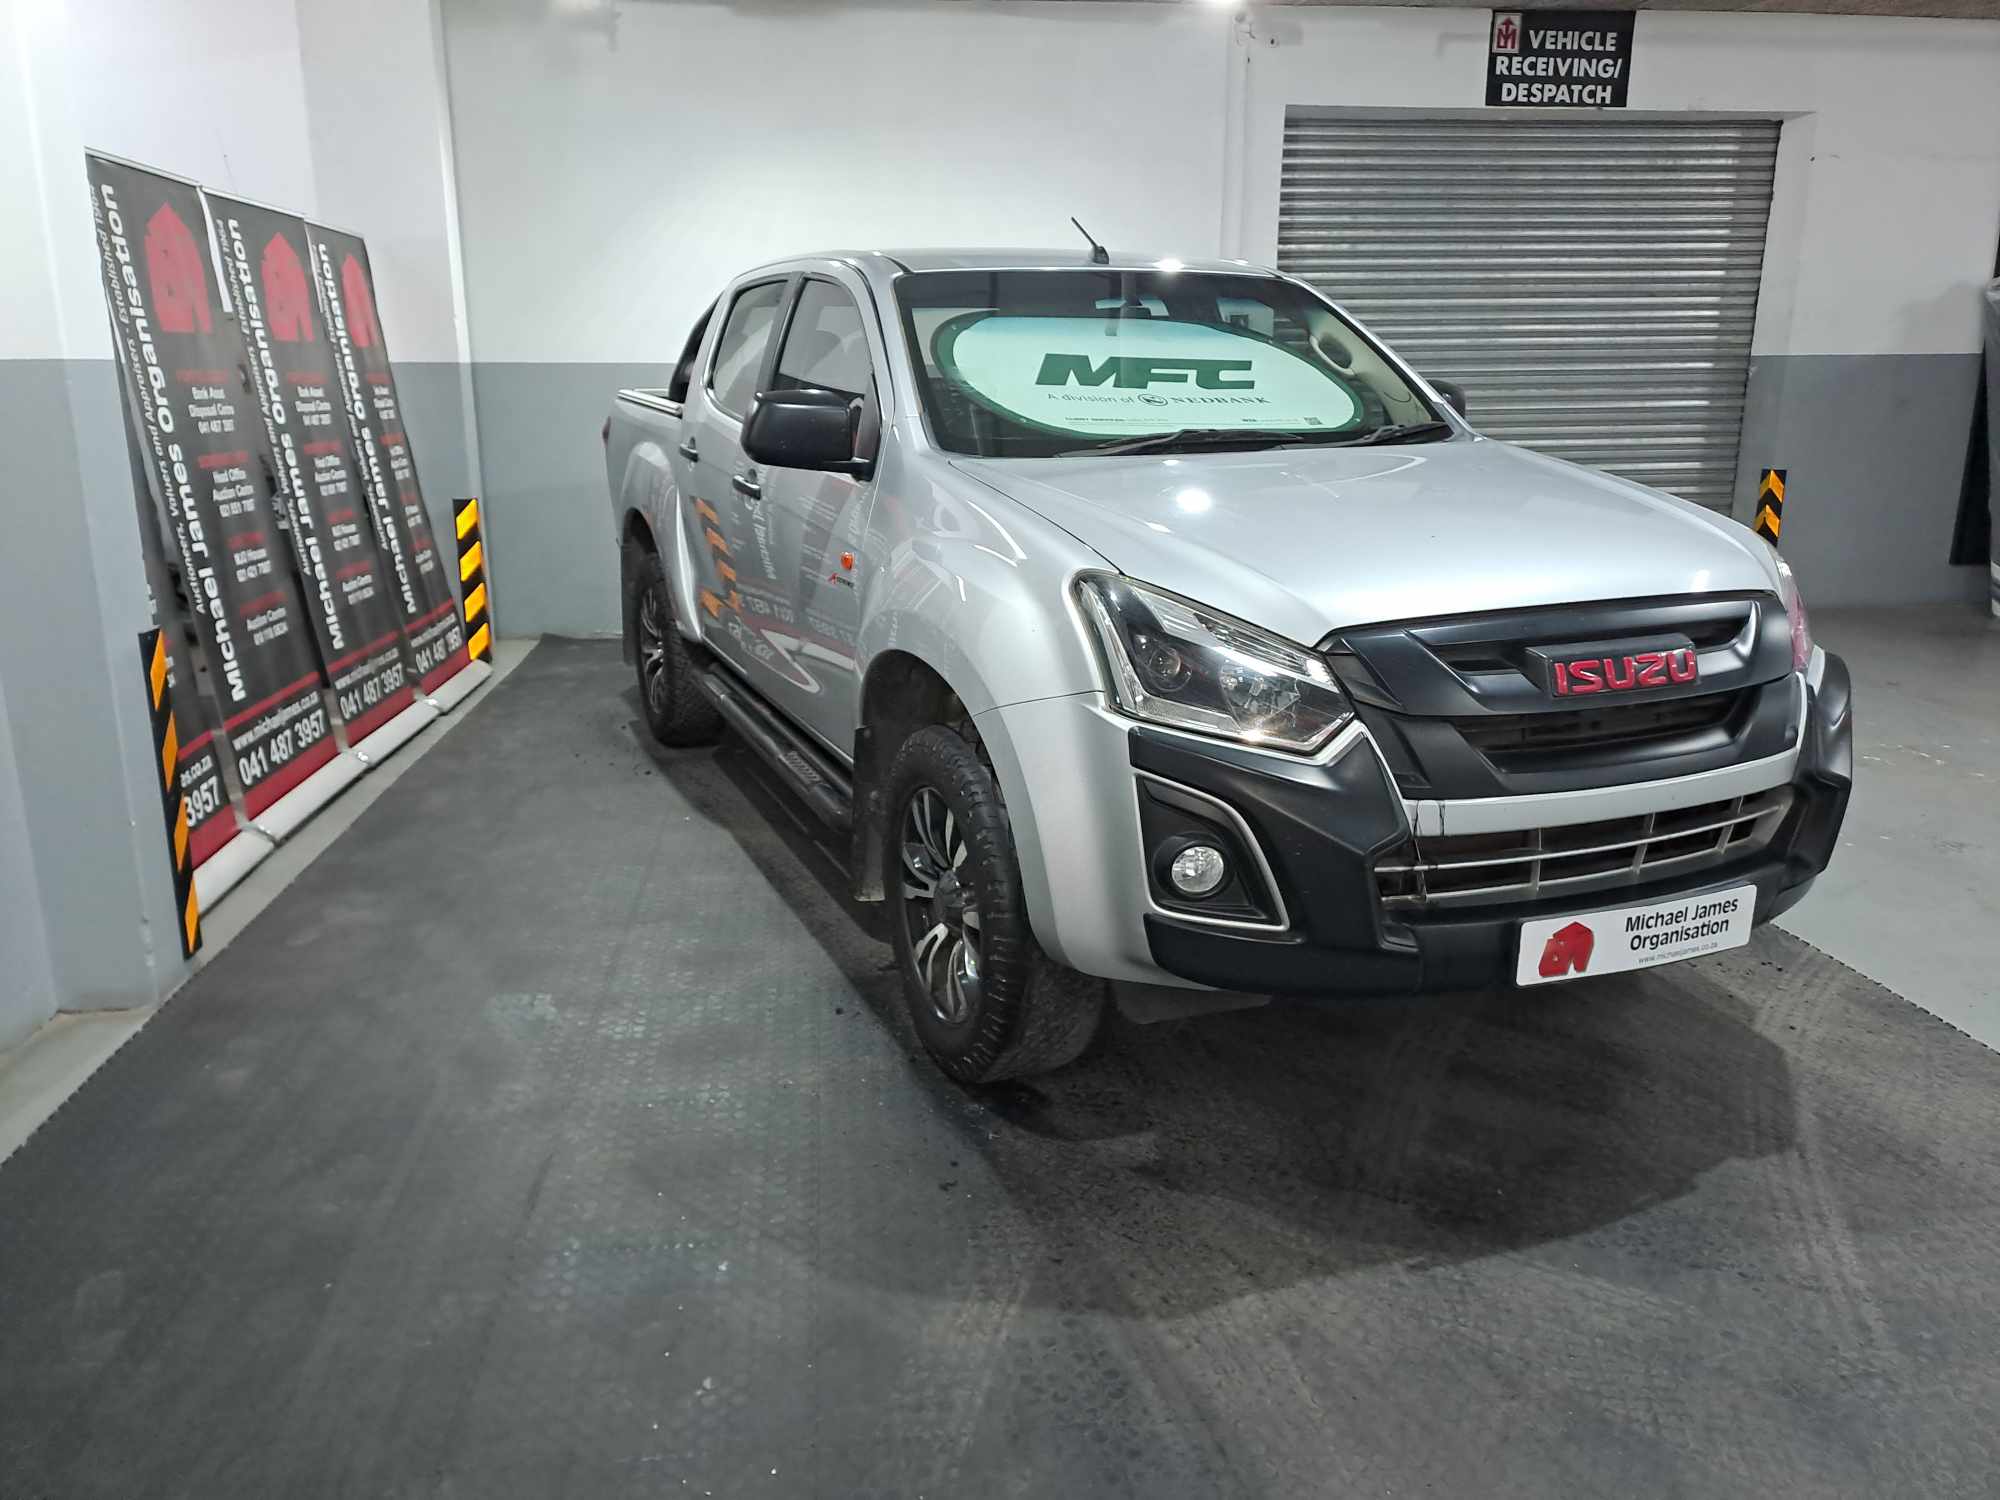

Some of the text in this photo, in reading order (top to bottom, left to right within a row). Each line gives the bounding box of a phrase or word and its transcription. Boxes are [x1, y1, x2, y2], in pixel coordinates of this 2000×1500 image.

[1495, 56, 1622, 78] RECEIVING/
[1529, 29, 1617, 51] VEHICLE
[1501, 82, 1611, 104] DESPATCH
[97, 228, 131, 325] Established
[101, 183, 175, 433] Organisation
[228, 218, 286, 425] Organisation
[318, 243, 366, 421] Organisation
[127, 337, 156, 423] Appraisers
[1035, 353, 1255, 390] MFC
[1169, 396, 1273, 405] NEDBANK
[148, 424, 163, 458] and
[361, 426, 390, 511] James
[159, 460, 179, 517] Valuers
[168, 443, 208, 558] James
[280, 432, 314, 529] James
[304, 536, 345, 650] Michael
[382, 515, 418, 614] Michael
[198, 566, 247, 702] Michael
[340, 662, 404, 720] 041 487 3957
[1554, 648, 1696, 696] ISUZU
[238, 708, 325, 786] 041 487 3957
[183, 775, 220, 828] 3957
[1625, 898, 1739, 932] Michael James
[1630, 918, 1730, 950] Organisation
